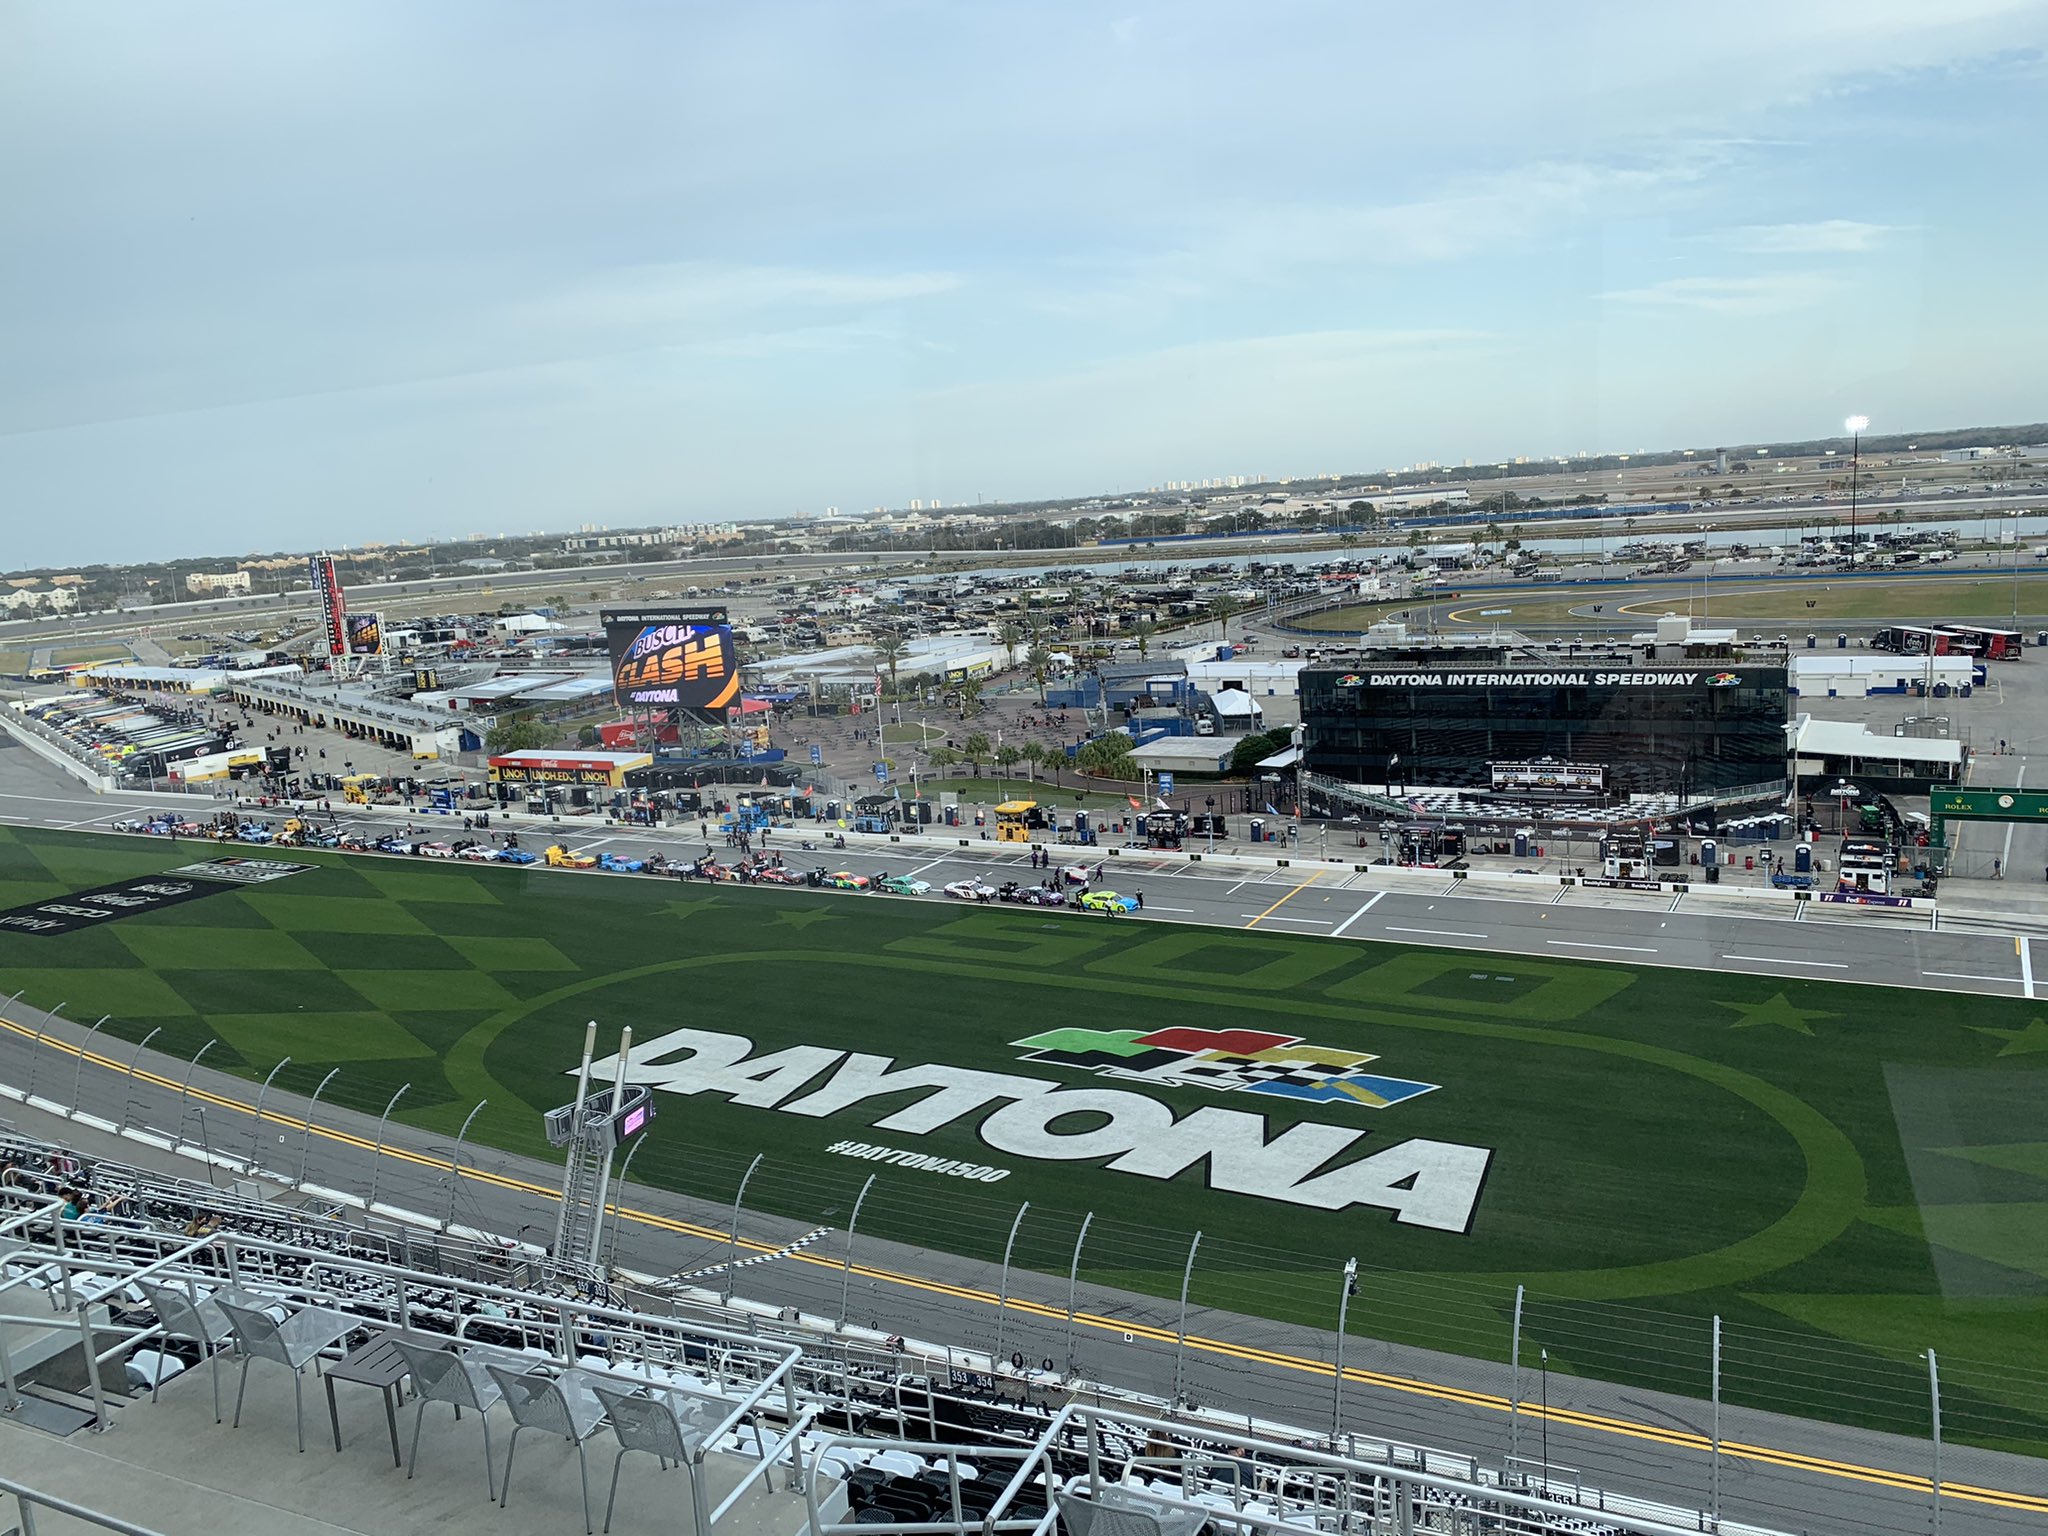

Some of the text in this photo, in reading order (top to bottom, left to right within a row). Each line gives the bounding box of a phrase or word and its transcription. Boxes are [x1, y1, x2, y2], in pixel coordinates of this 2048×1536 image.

[618, 633, 725, 689] CLASH
[1369, 673, 1699, 686] DAYTONA INTERNATIONAL SPEEDWAY
[635, 688, 678, 702] DAYTONA
[502, 768, 526, 779] UNOH
[581, 770, 606, 781] UNOH
[1631, 882, 1659, 890] Smithfield
[1846, 896, 1867, 904] FedEx
[37, 904, 114, 918] GEICO
[564, 1027, 1494, 1235] DAYTONA
[825, 1139, 1011, 1184] #DAYTONA500
[951, 1369, 993, 1388] 353 354
[1548, 1493, 1572, 1506] 355
